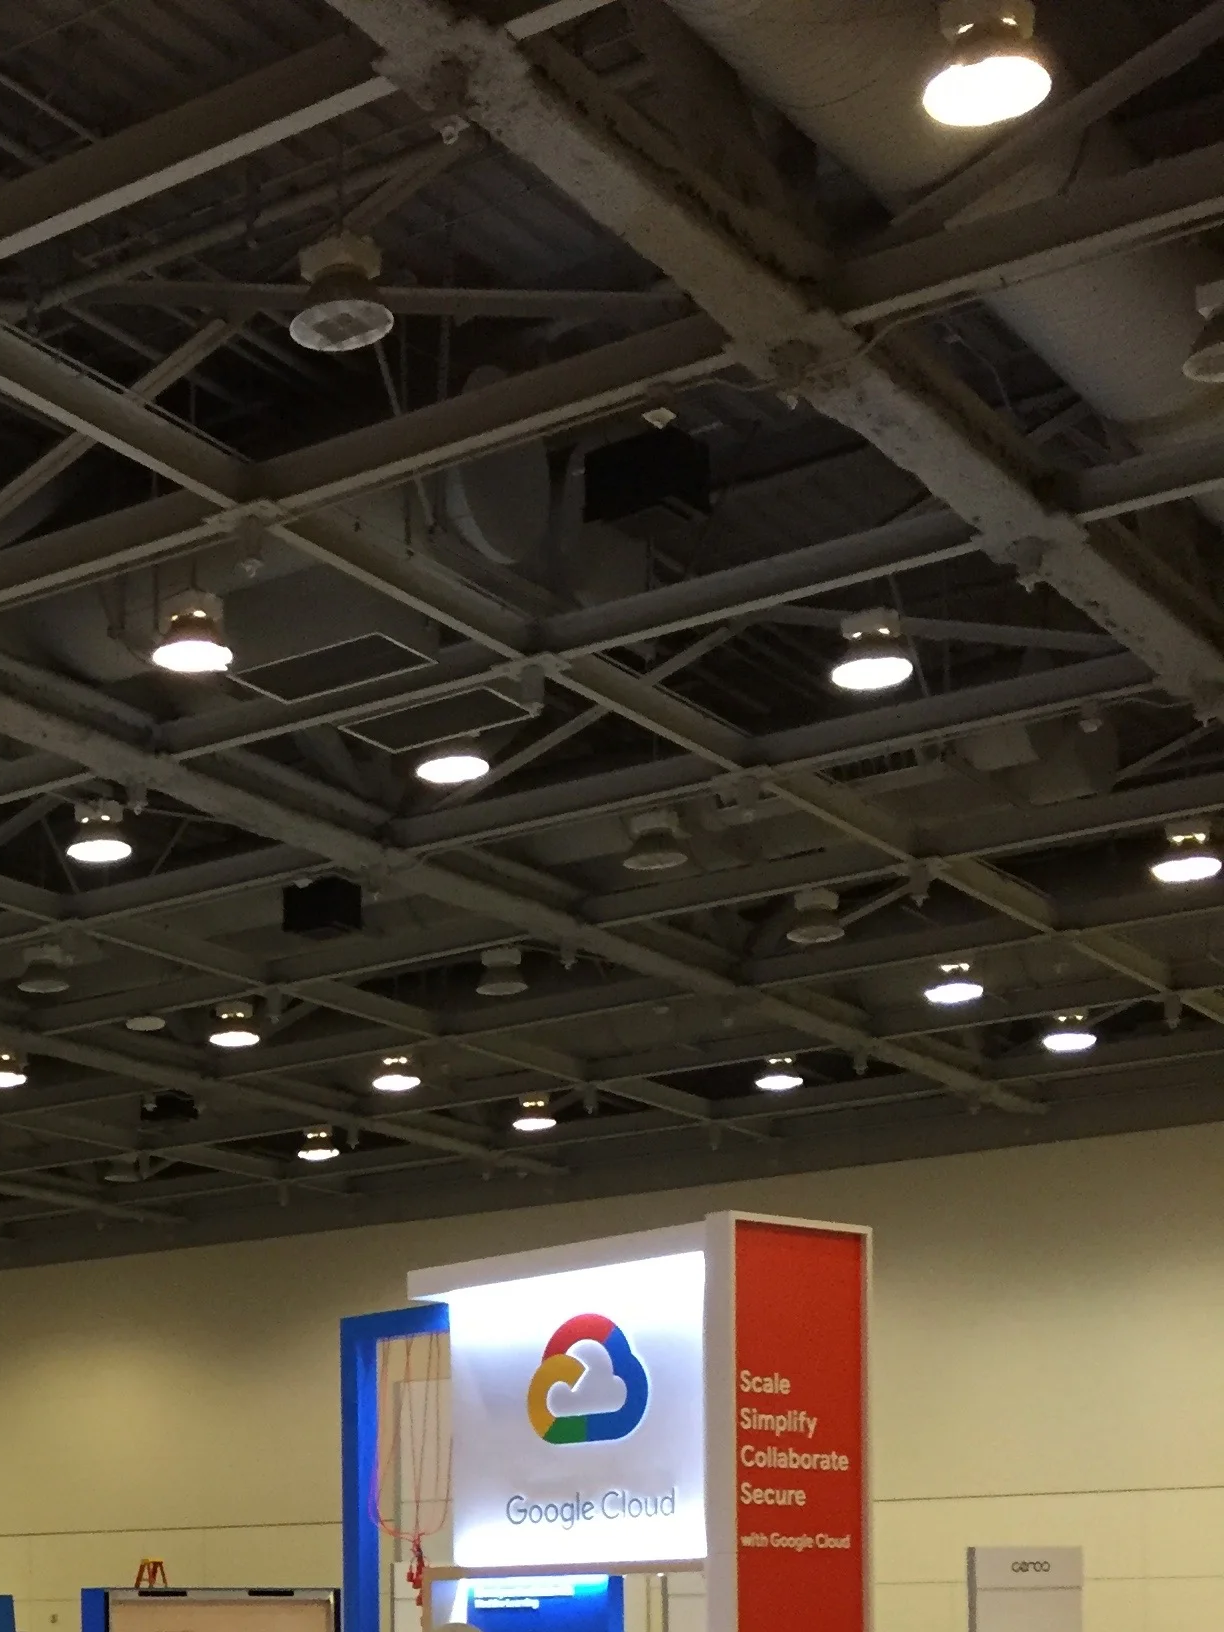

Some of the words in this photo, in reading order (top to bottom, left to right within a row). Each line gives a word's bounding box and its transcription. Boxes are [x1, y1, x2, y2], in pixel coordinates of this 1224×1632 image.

[739, 1369, 792, 1395] Scale
[739, 1407, 818, 1439] Simplify
[739, 1444, 850, 1472] Collaborate
[739, 1482, 807, 1507] Secure
[506, 1491, 595, 1531] Google
[601, 1486, 676, 1520] Cloud
[739, 1531, 769, 1548] with
[769, 1532, 814, 1553] Google
[814, 1533, 852, 1550] Cloud
